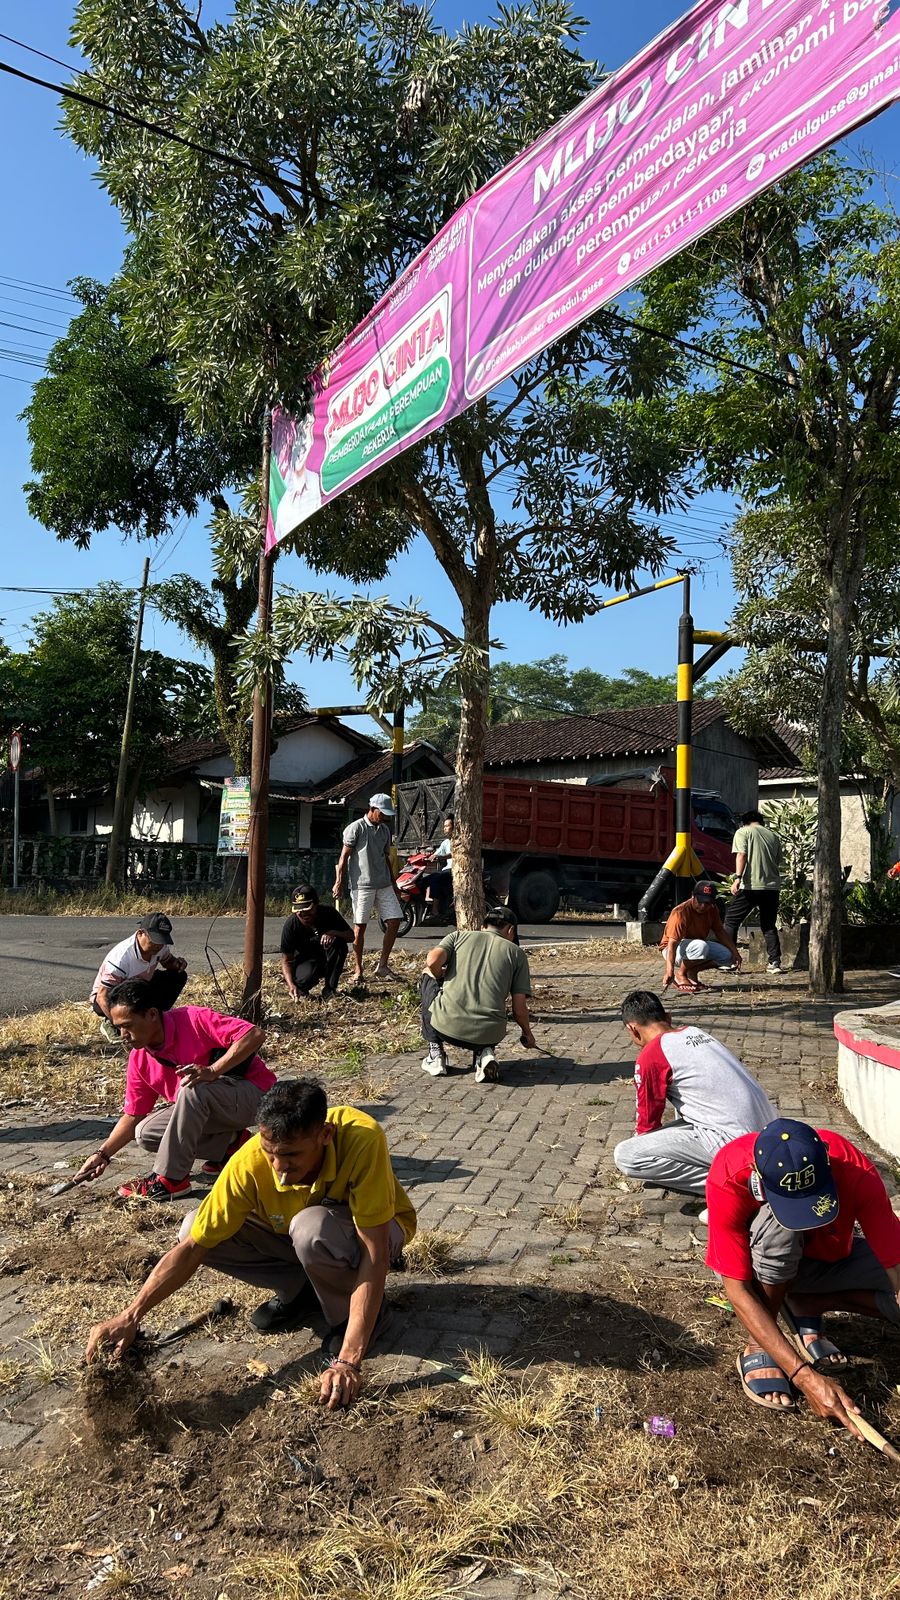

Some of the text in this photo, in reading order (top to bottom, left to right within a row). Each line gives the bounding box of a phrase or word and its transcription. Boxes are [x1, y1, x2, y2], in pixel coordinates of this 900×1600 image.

[477, 221, 557, 294] Menyediakan
[561, 181, 602, 224] akses
[605, 92, 715, 192] permodalan,
[718, 15, 814, 101] jaminan
[498, 274, 521, 297] dan
[524, 215, 594, 277] dukungan
[597, 106, 734, 224] pemberdayaan
[738, 11, 836, 108] ekonomi
[533, 0, 775, 205] MLIJO CIN
[768, 55, 900, 163] wadulguse@gmai
[576, 117, 748, 266] perempuan pekerja
[328, 363, 443, 465] PEMBERDAYAAN PEREMPUAN
[329, 369, 379, 438] MLIJO
[383, 308, 444, 389] CINTA
[361, 425, 396, 459] PEKERJA
[780, 1164, 815, 1191] 46
